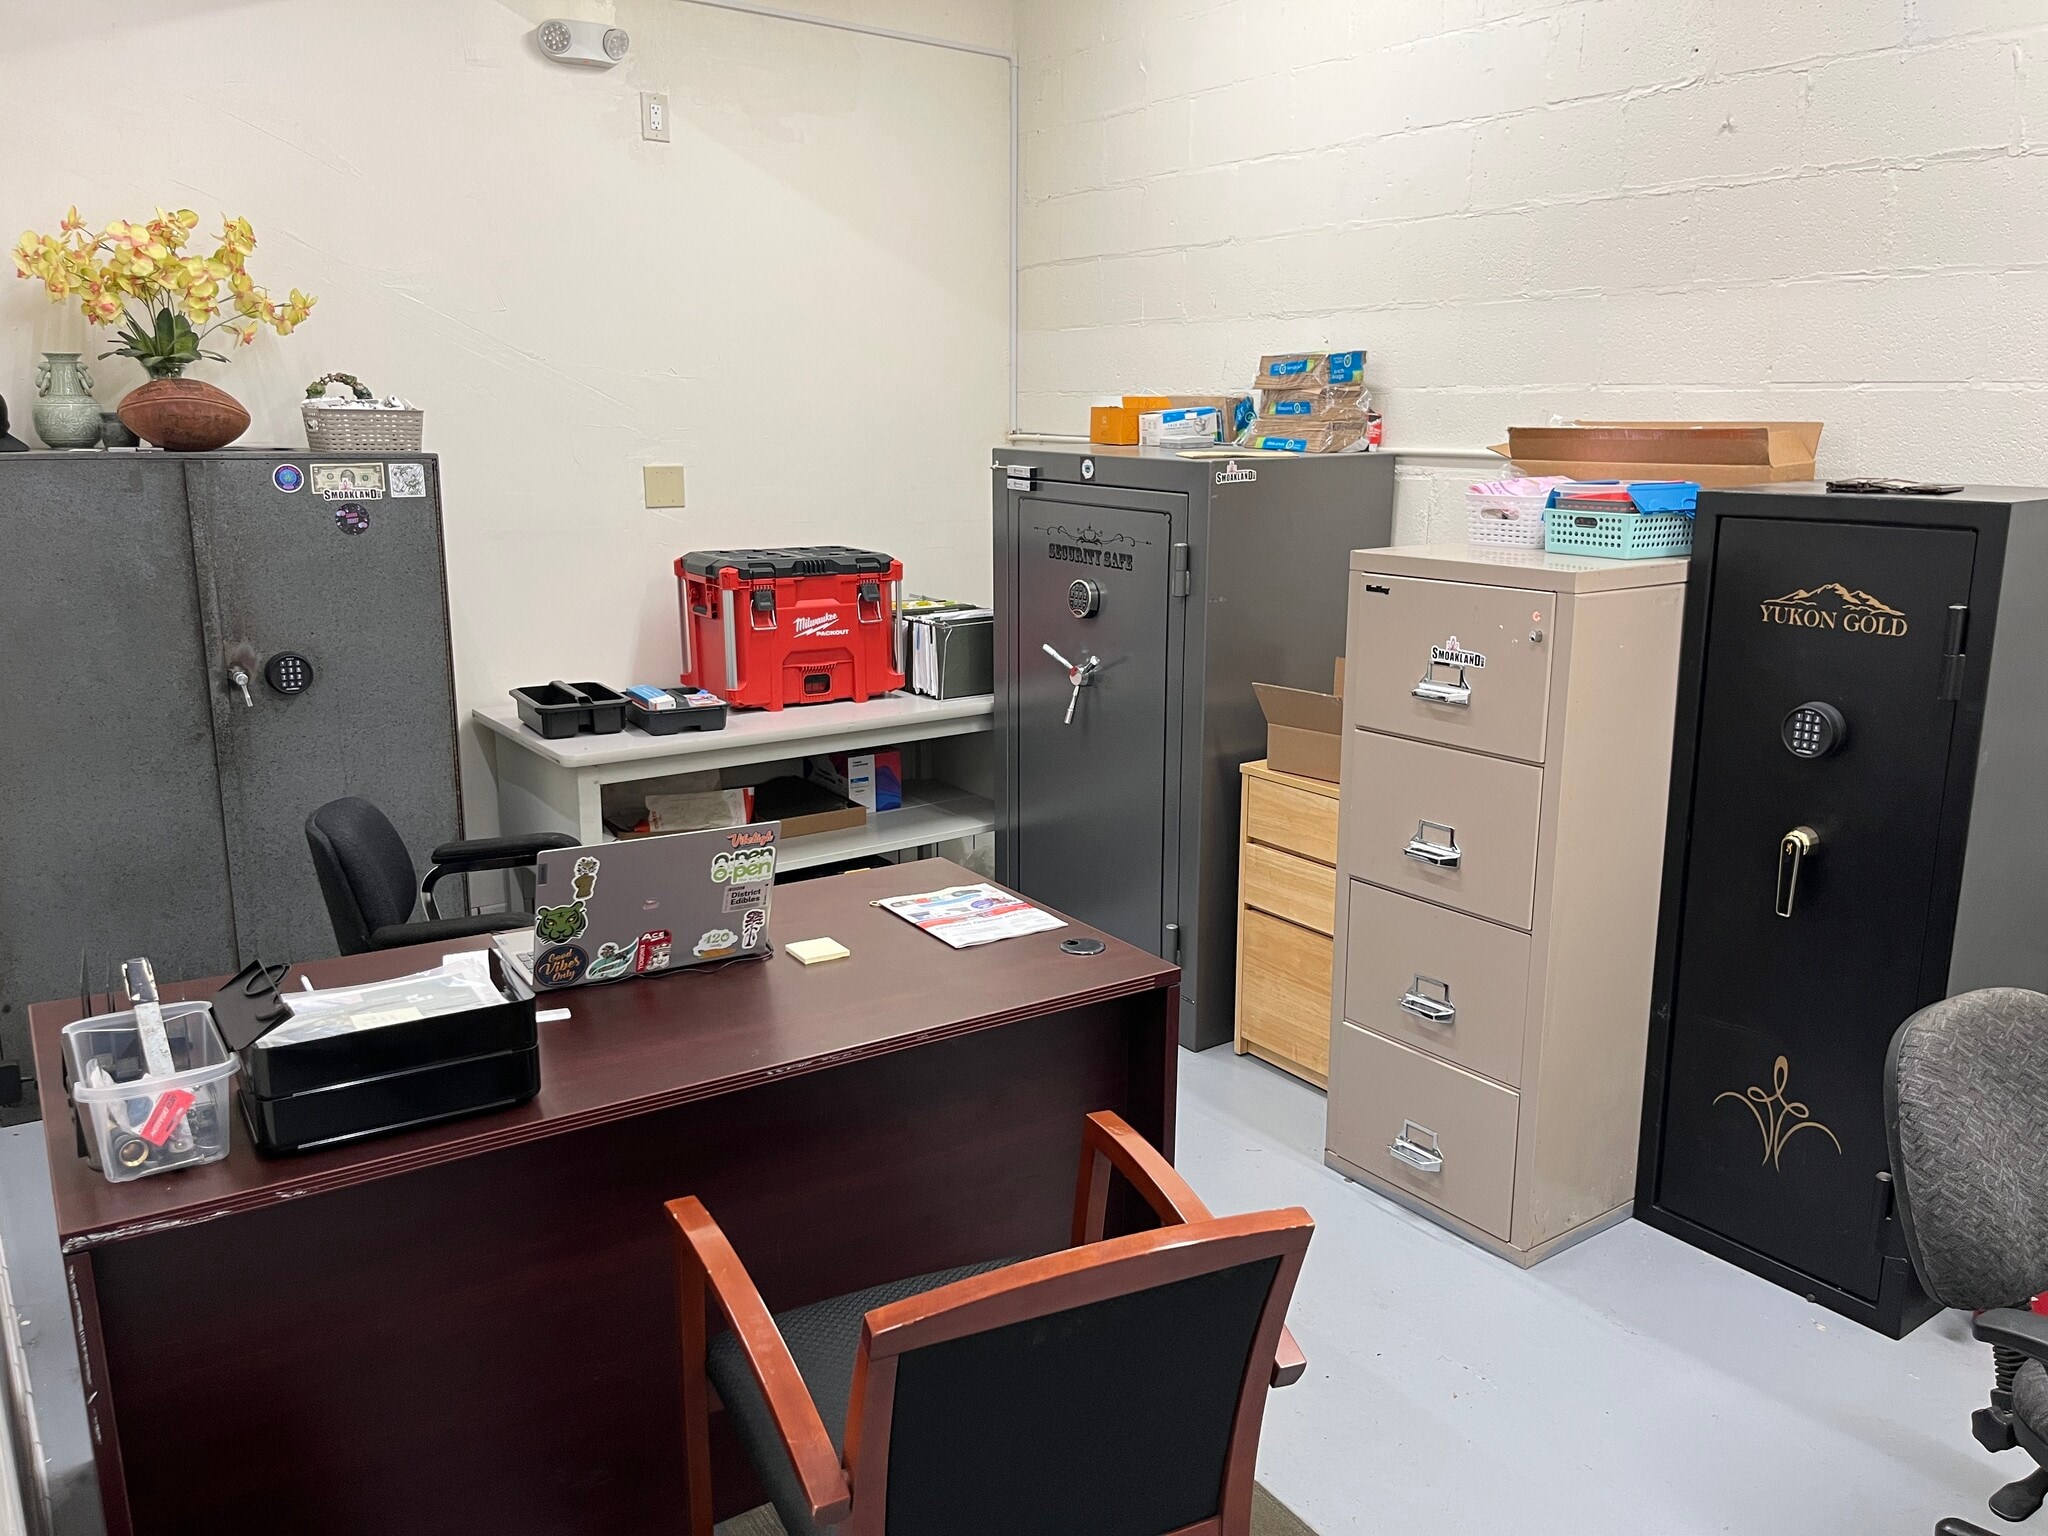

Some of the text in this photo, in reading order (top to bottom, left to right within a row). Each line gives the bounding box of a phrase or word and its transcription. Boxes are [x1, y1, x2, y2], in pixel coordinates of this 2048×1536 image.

[1217, 471, 1253, 483] SMOAKLAND
[324, 489, 377, 500] SMOAKLAND
[1049, 543, 1133, 571] SECURITY SAFE
[793, 612, 838, 632] Milwaukee
[1760, 604, 1908, 637] YUKON GOLD
[816, 629, 849, 637] PACKOUT
[1432, 647, 1481, 667] SMOAKLAND
[731, 888, 761, 899] District
[730, 896, 761, 906] Edibles
[641, 931, 665, 942] ACE
[548, 949, 573, 963] Good
[539, 957, 581, 977] Vibes
[552, 969, 576, 983] Only
